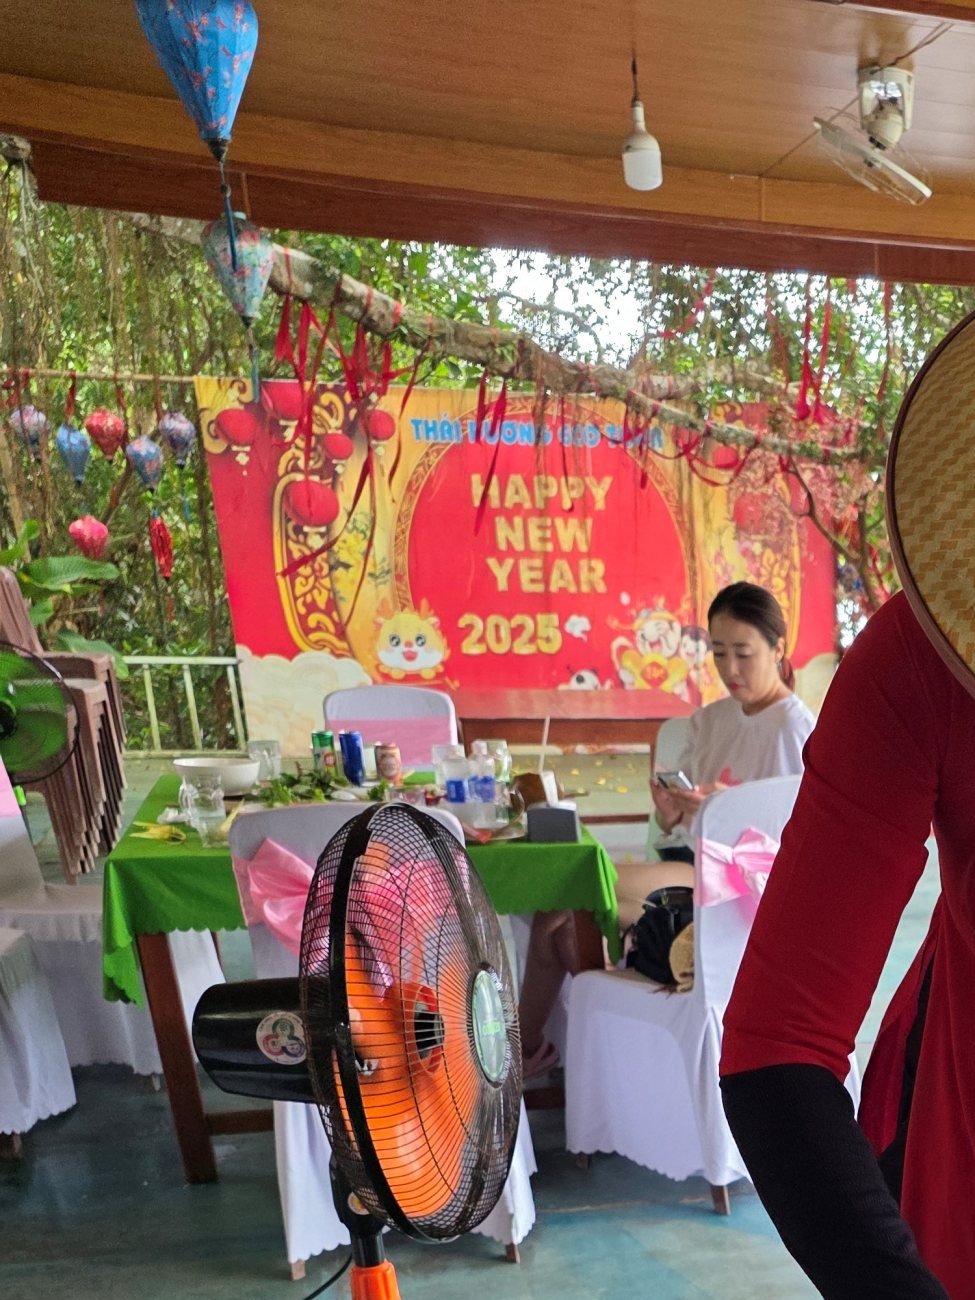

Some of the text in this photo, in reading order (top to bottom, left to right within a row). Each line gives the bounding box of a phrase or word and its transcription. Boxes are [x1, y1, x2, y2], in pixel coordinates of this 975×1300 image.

[410, 412, 462, 443] THÁI
[470, 473, 613, 511] HAPPY
[495, 516, 593, 552] NEW
[486, 557, 607, 593] YEAR
[457, 613, 563, 655] 2025
